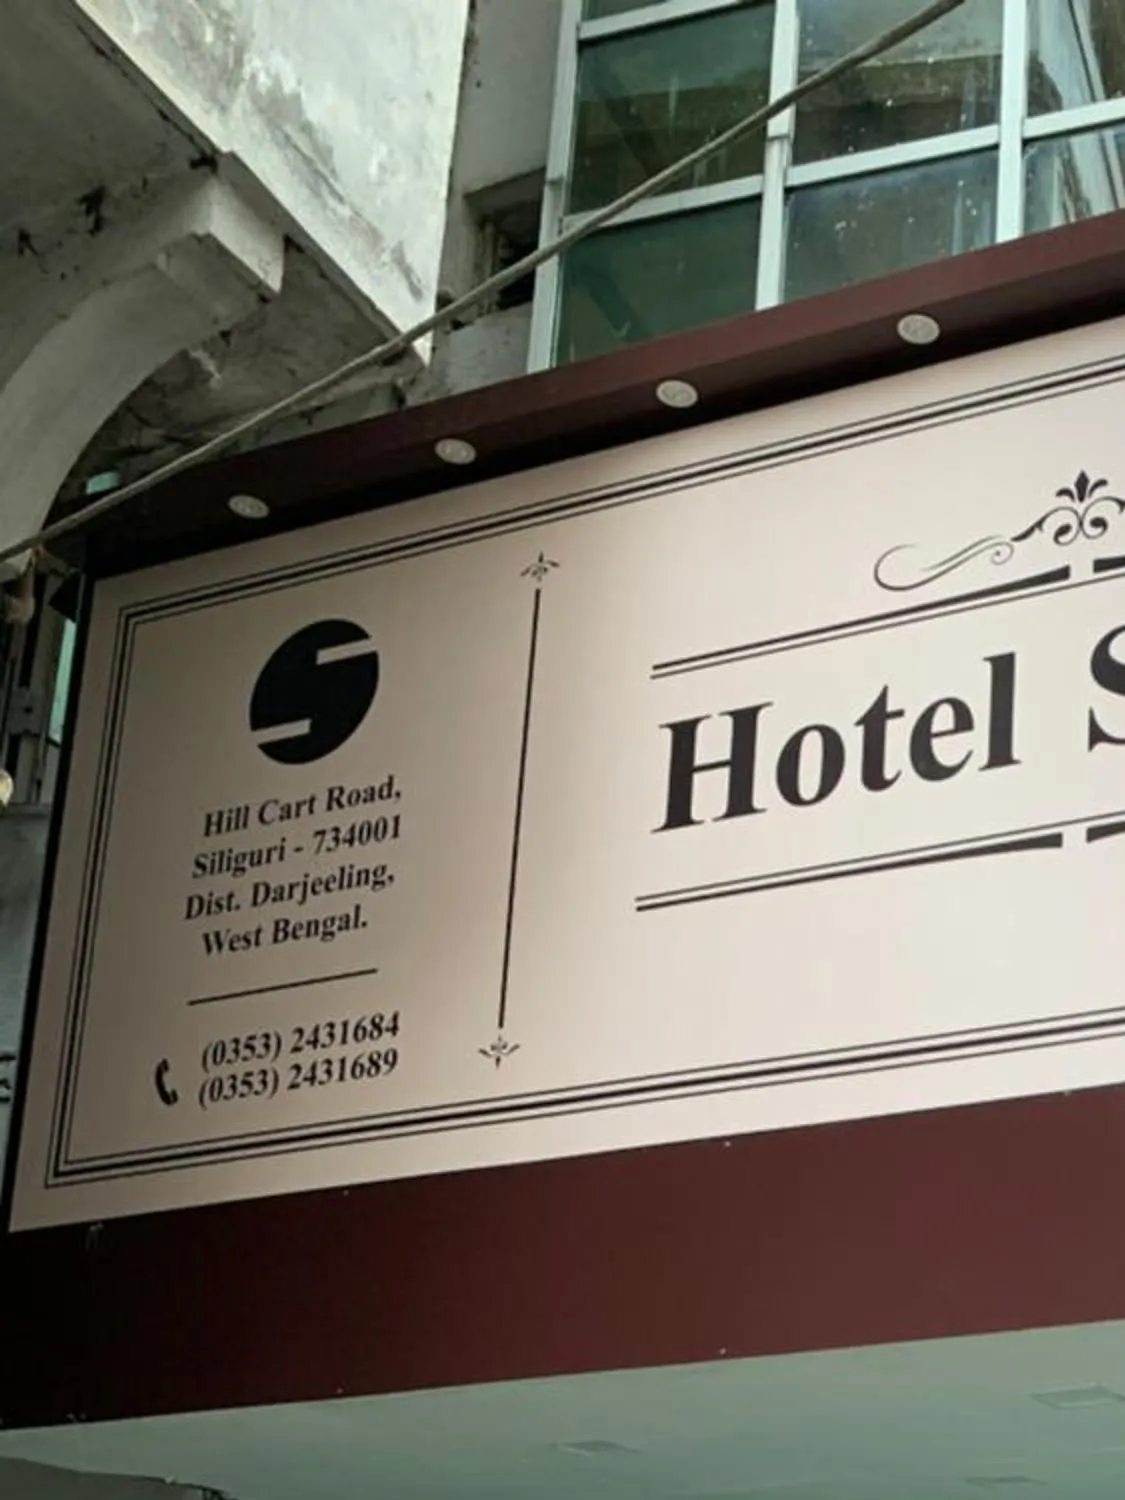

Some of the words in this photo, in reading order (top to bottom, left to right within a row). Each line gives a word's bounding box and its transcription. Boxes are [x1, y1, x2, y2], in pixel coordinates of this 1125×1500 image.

[651, 652, 1022, 834] Hotel
[203, 804, 249, 838] Hill
[258, 795, 316, 826] Cart
[326, 774, 402, 812] Road,
[192, 837, 286, 879] Siliguri
[312, 814, 401, 855] 734001
[184, 893, 241, 921] Dist.
[251, 864, 395, 906] Darjeeling,
[202, 925, 263, 956] West
[272, 903, 368, 942] Bengal.
[202, 1030, 283, 1074] (0353)
[289, 1010, 400, 1054] 2431684
[198, 1066, 280, 1110] (0353)
[287, 1048, 399, 1090] 2431689
